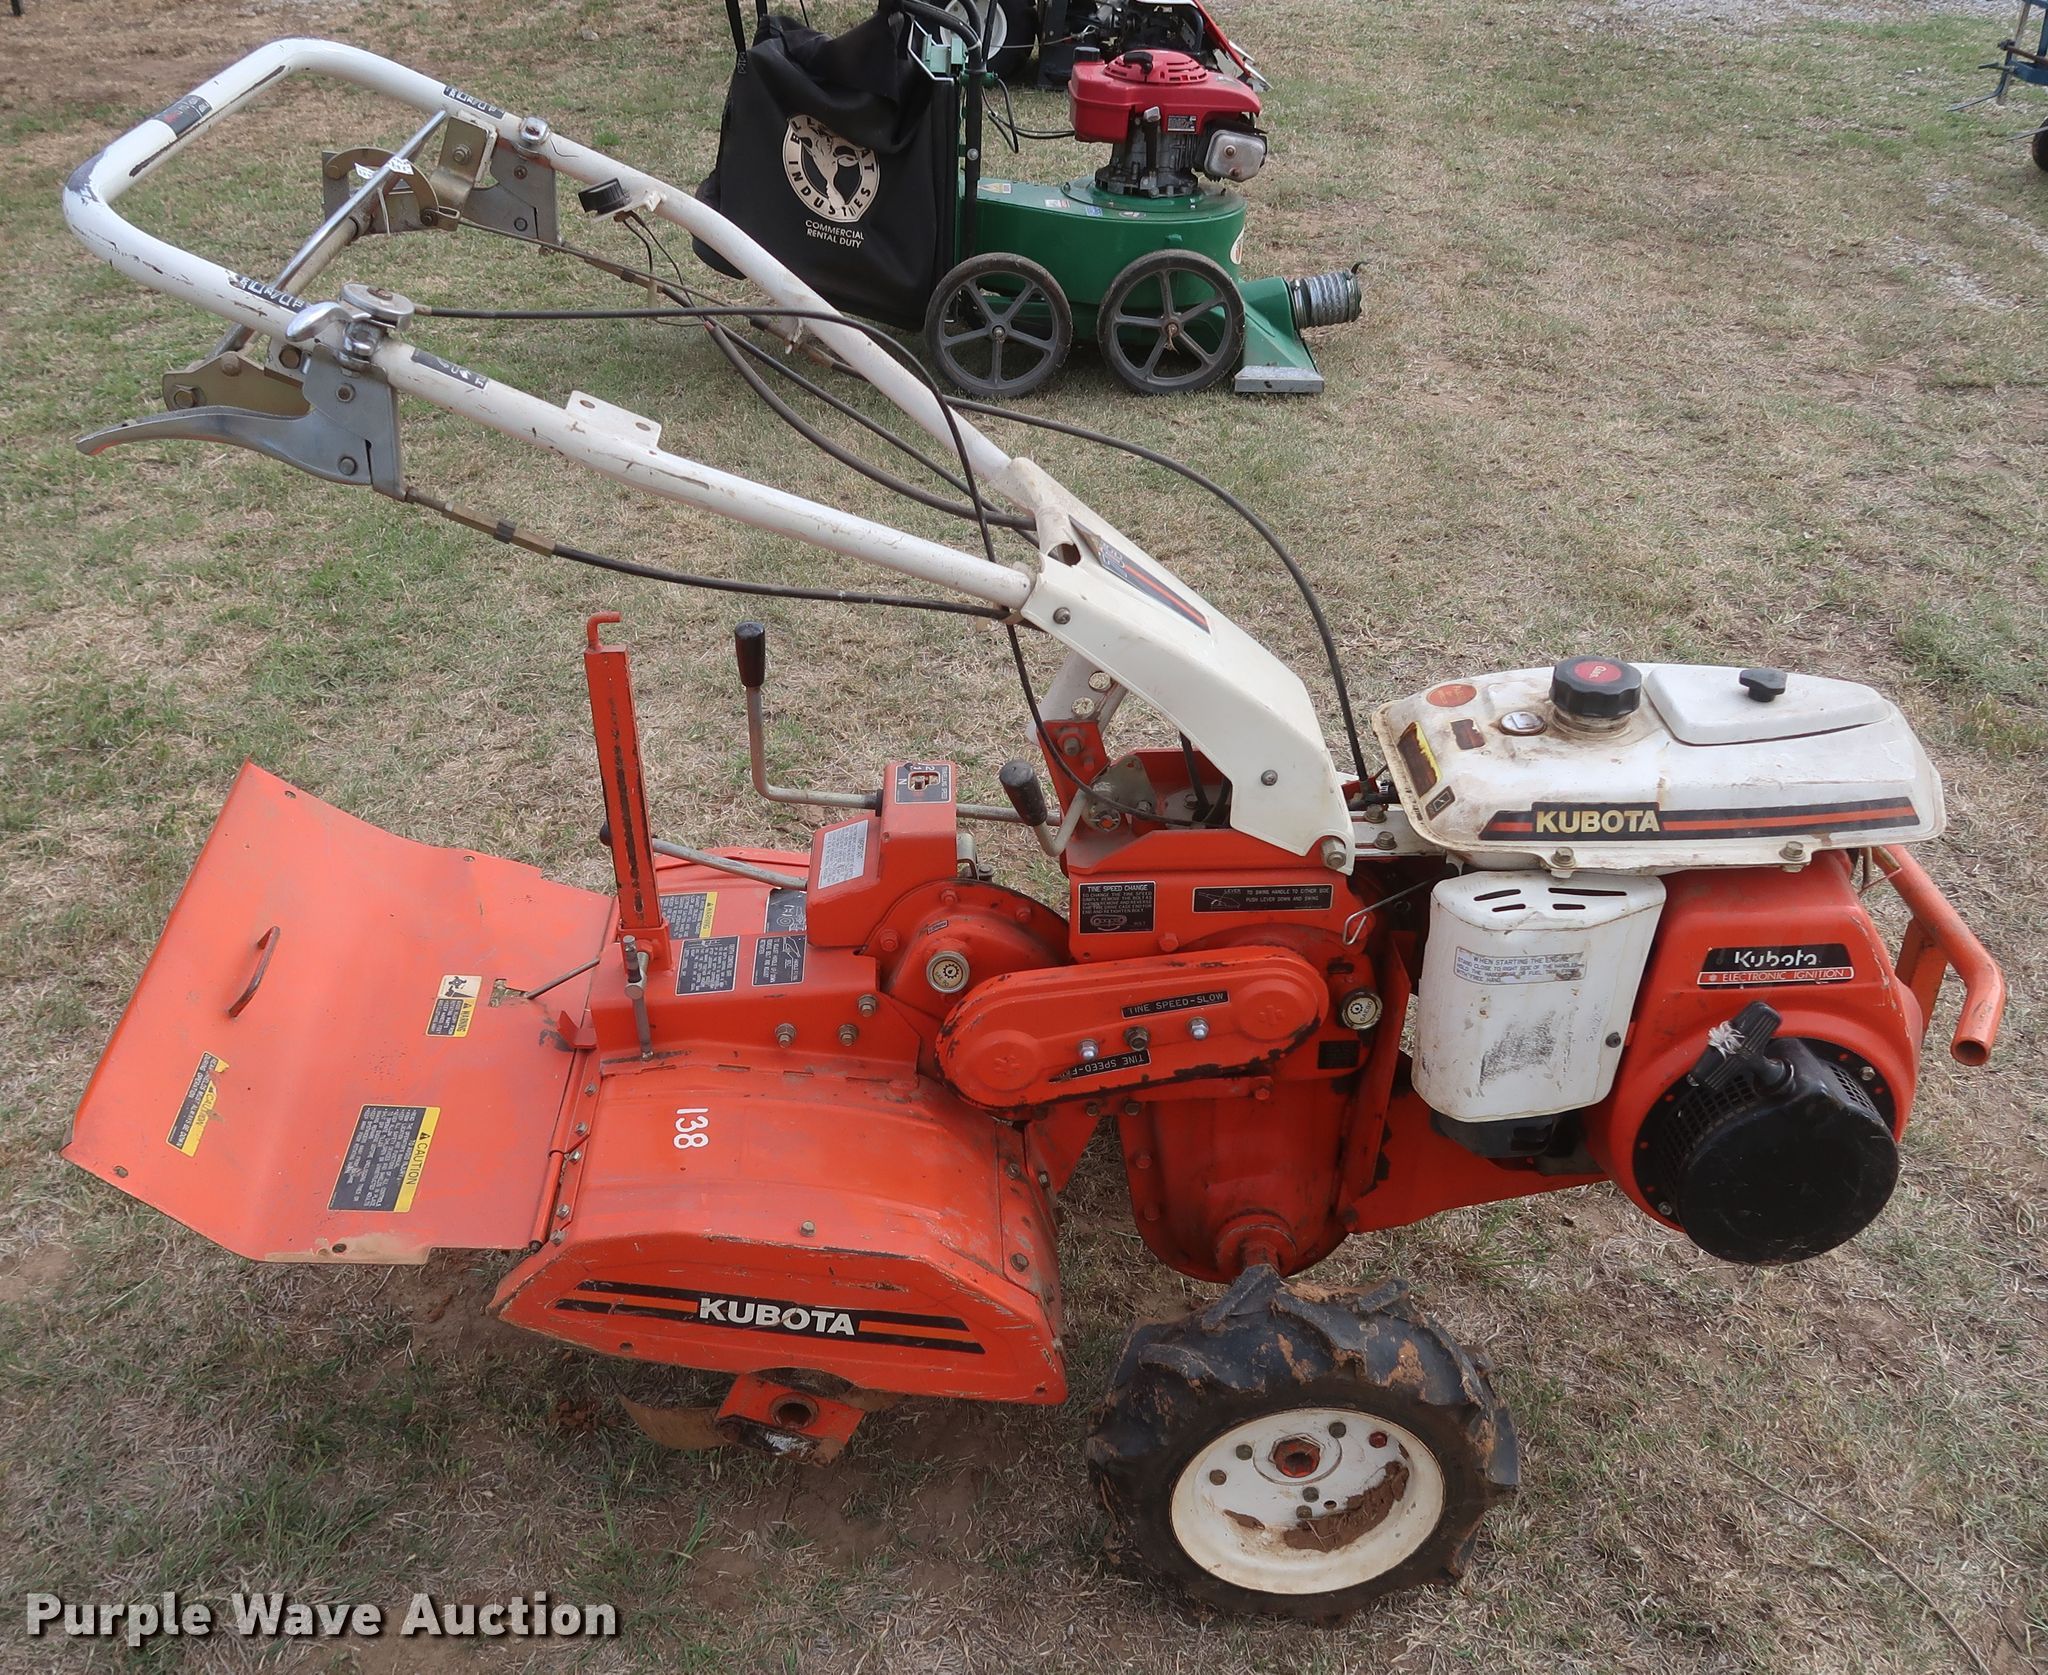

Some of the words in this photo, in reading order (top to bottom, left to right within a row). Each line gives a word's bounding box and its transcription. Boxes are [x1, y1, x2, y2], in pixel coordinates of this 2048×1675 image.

[805, 220, 864, 240] COMMERCIAL
[807, 229, 837, 243] RENTAL
[839, 237, 862, 248] DUTY
[1536, 809, 1660, 834] KUBOTA
[1474, 963, 1491, 971] CLOSE
[1735, 949, 1817, 967] Kubota
[1722, 971, 1787, 982] ELECTRONIC
[1793, 969, 1845, 979] IGNITION
[1128, 1004, 1150, 1015] TINE
[1155, 993, 1224, 1010] SPEED-SLOW
[1121, 1054, 1144, 1065] TINE
[673, 1108, 709, 1149] 138
[406, 1142, 428, 1184] CAUTION
[699, 1297, 855, 1336] KUBOTA
